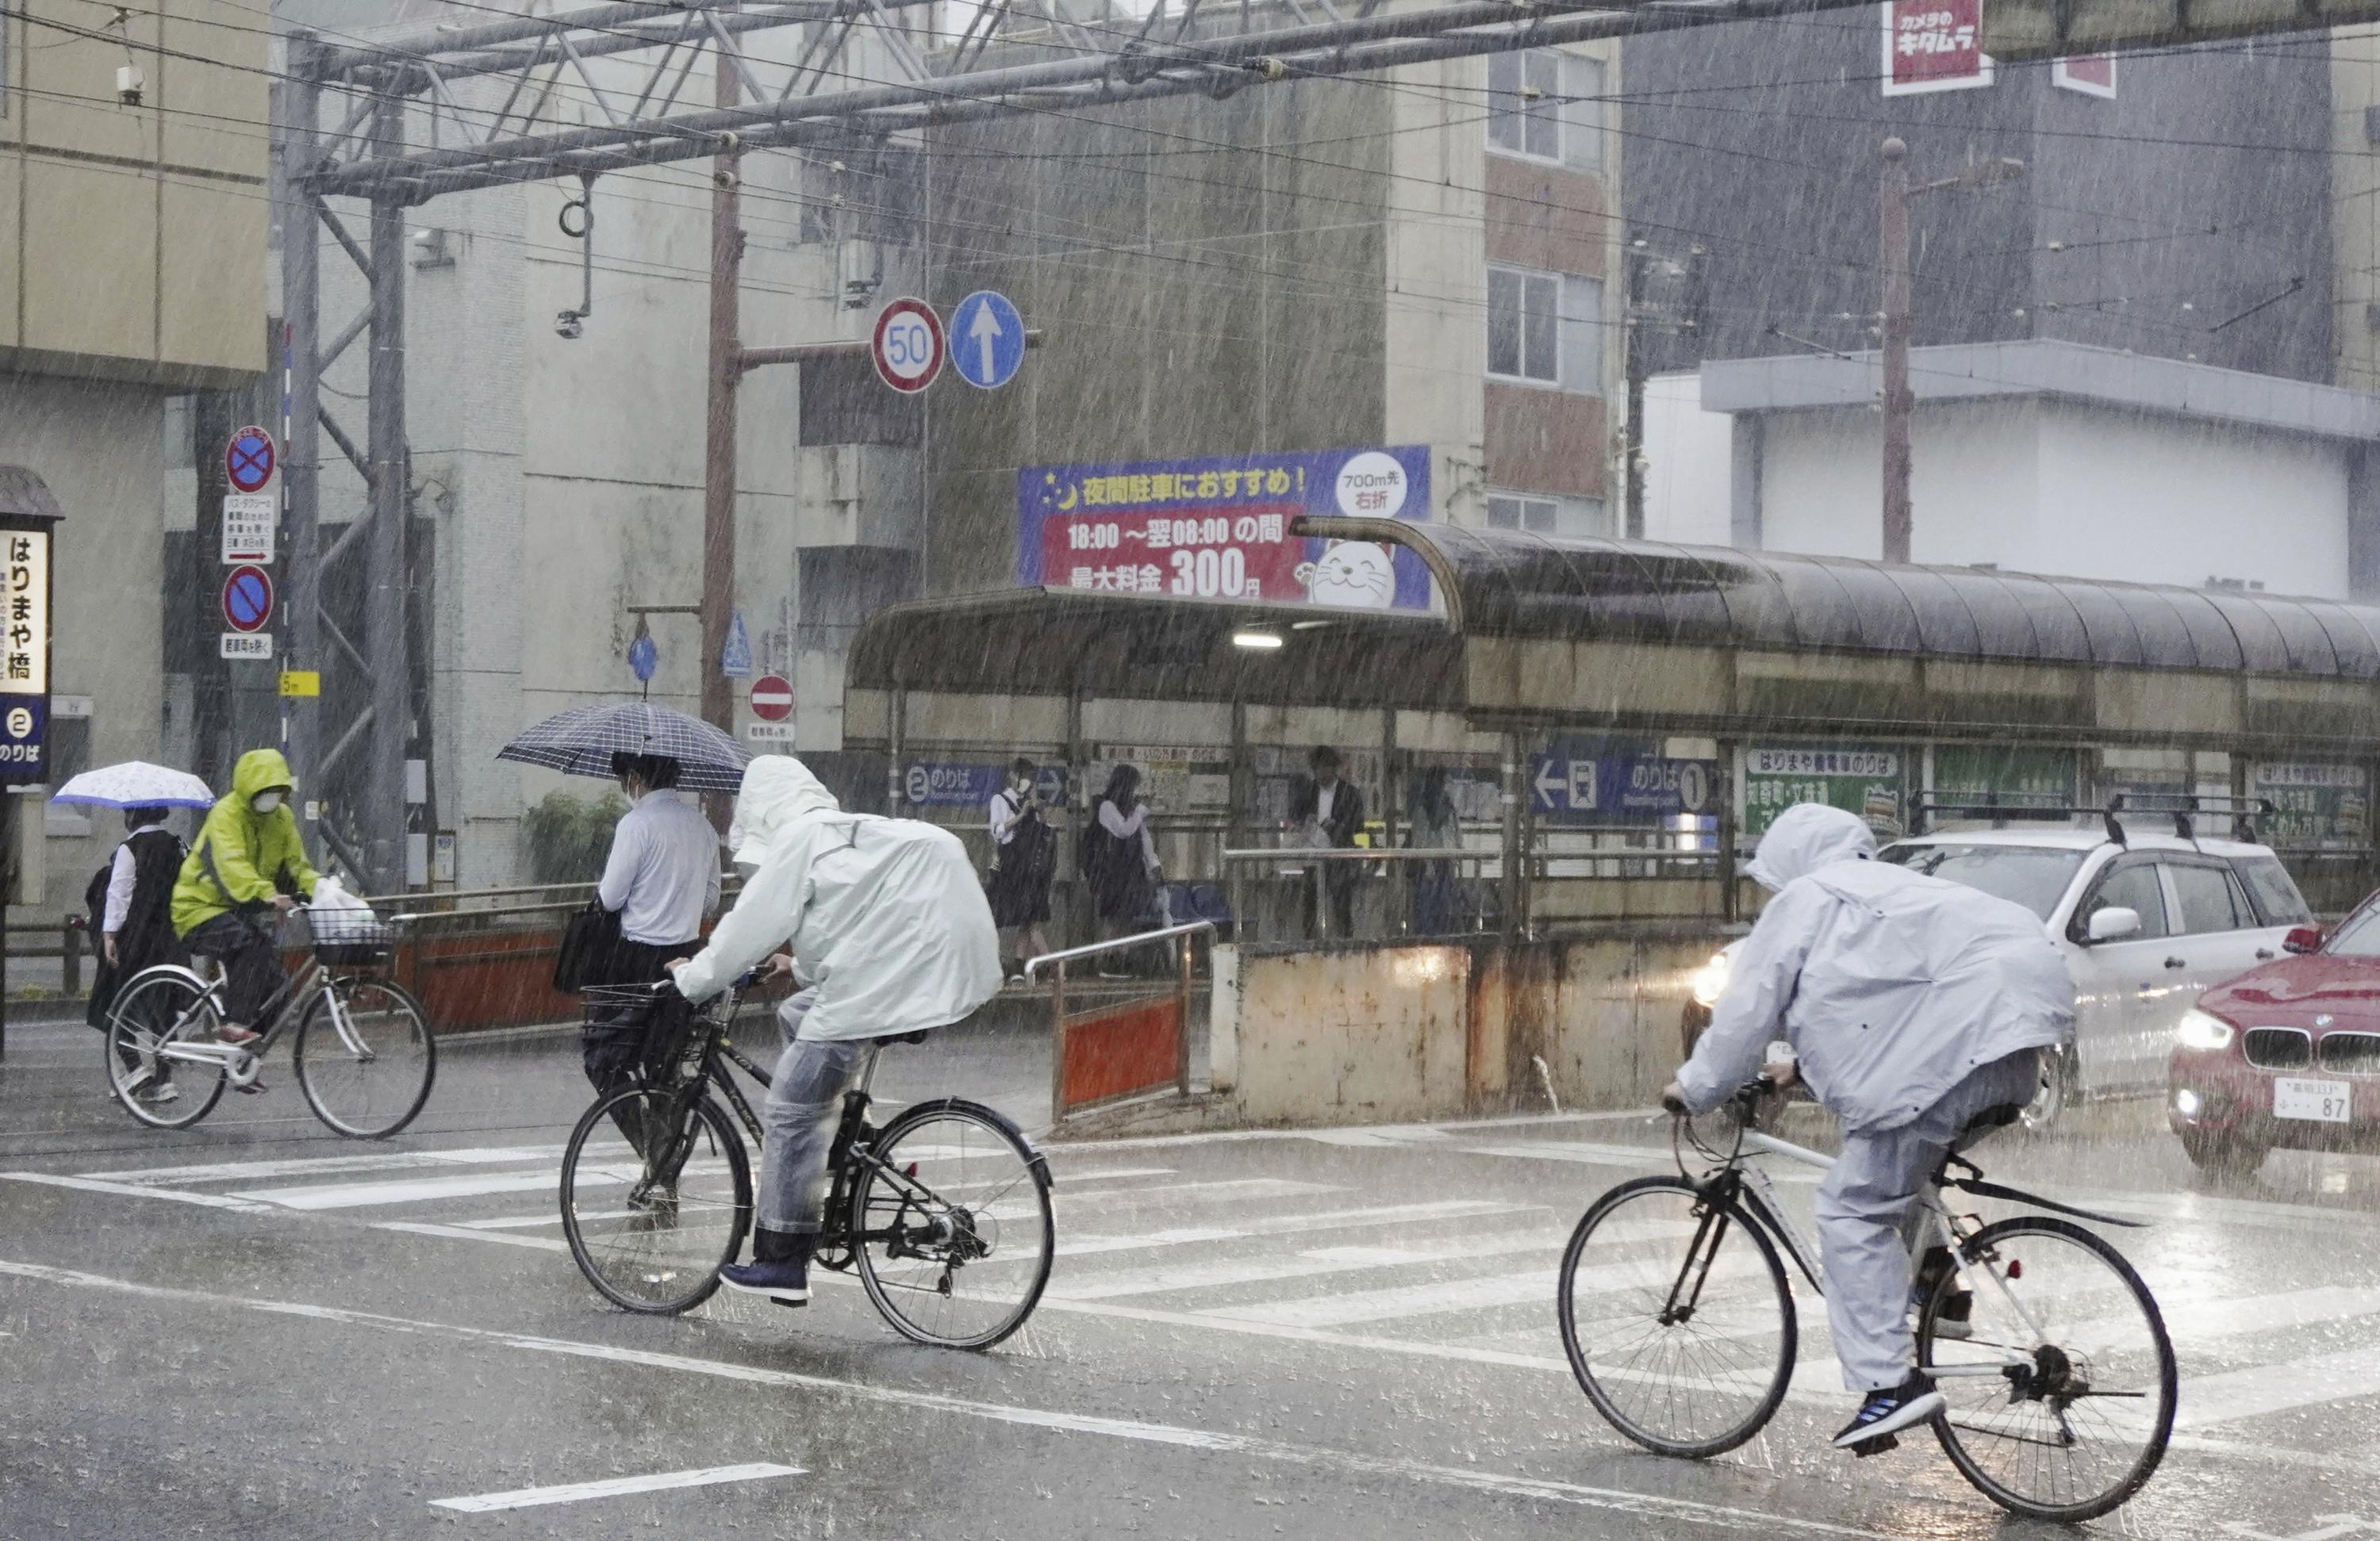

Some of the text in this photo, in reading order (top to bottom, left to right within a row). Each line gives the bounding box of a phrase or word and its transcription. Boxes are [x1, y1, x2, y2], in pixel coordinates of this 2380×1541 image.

[1898, 25, 1975, 56] キタムラ
[888, 324, 927, 366] 50
[1343, 470, 1399, 489] 700m先
[1355, 490, 1388, 511] 右折
[1071, 563, 1163, 592] 最大料金
[7, 535, 33, 680] はりまや橋
[0, 744, 40, 762] のりば
[931, 767, 972, 790] のりば
